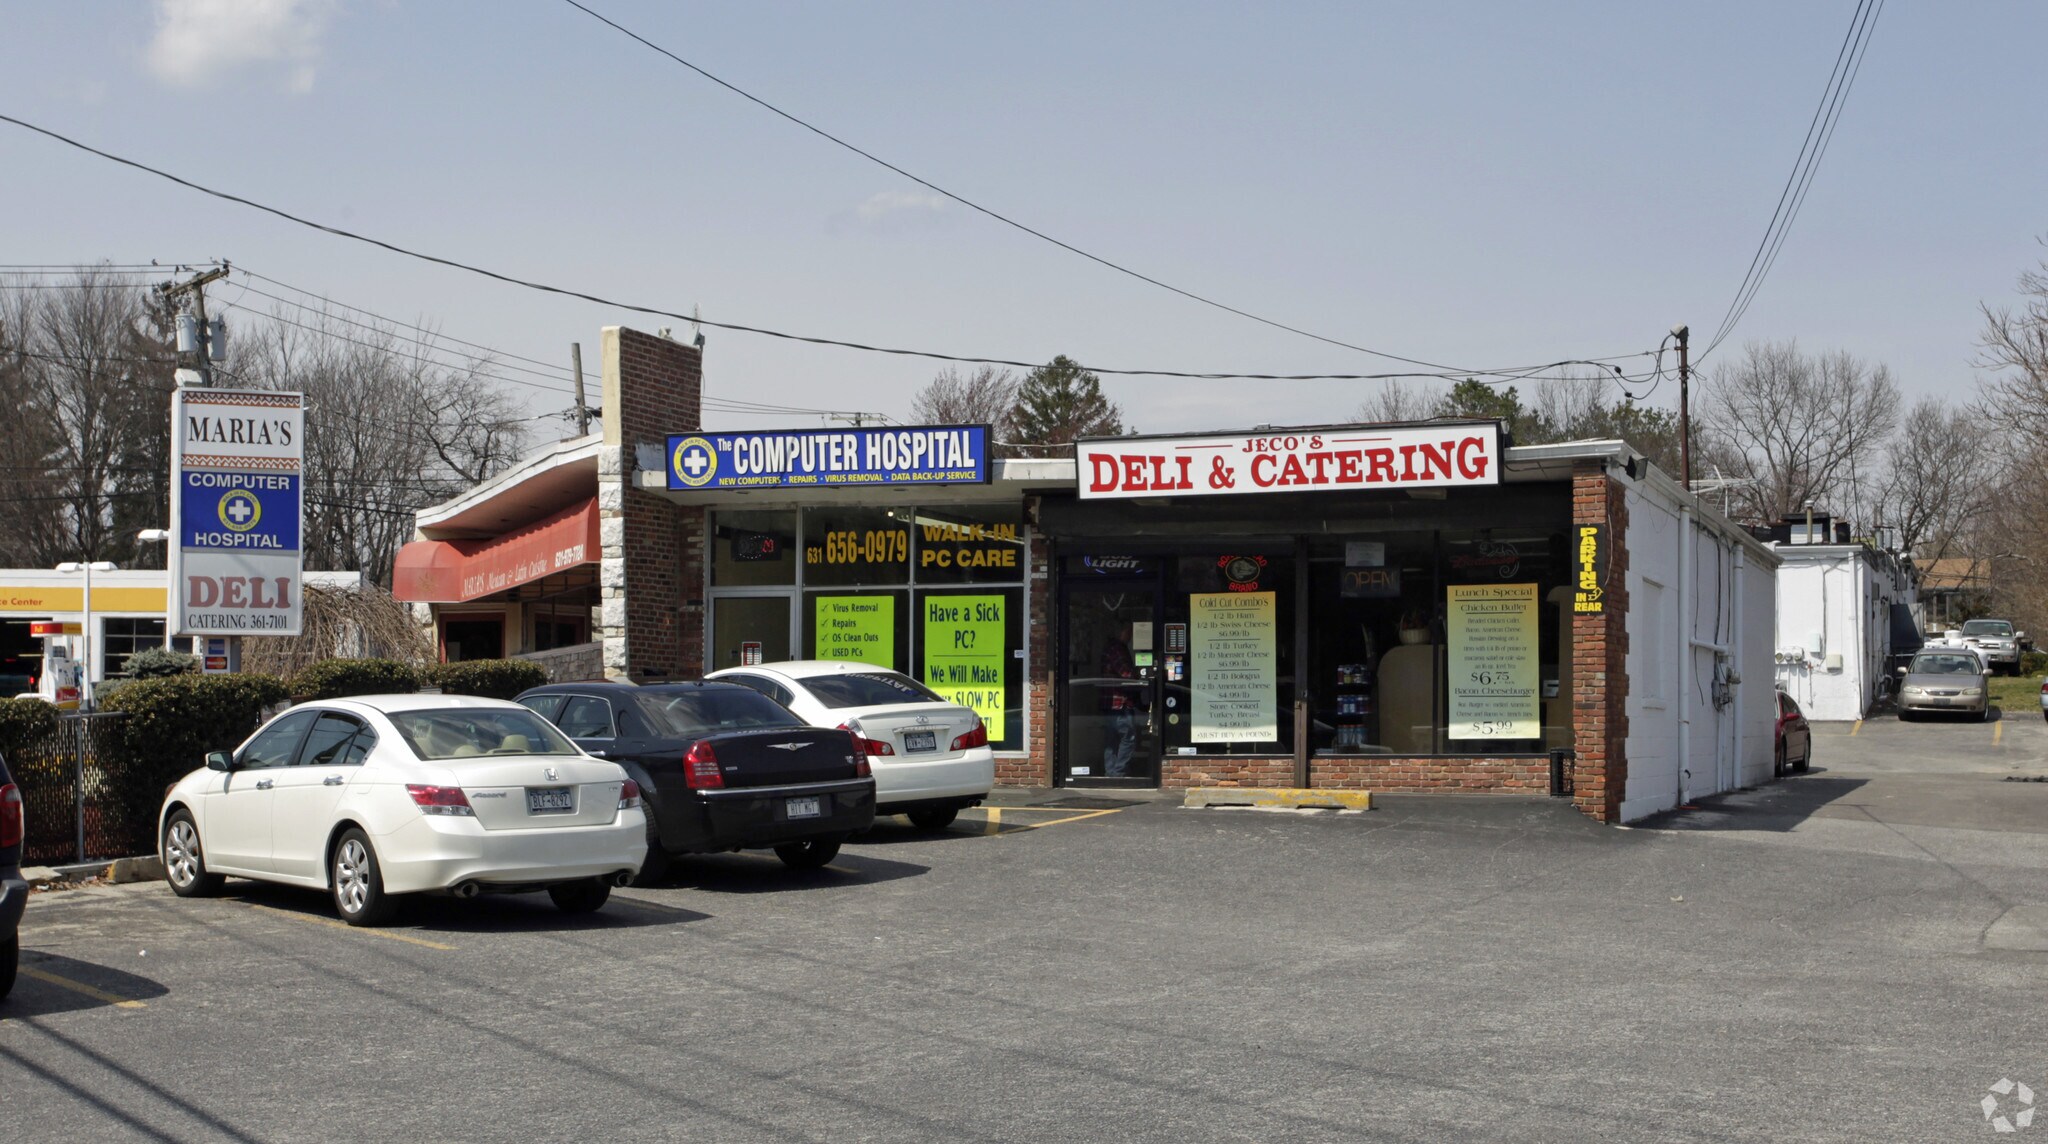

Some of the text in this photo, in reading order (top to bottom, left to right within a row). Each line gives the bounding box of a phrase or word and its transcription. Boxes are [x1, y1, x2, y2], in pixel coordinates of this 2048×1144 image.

[188, 416, 292, 446] MARIA'S
[1242, 436, 1323, 452] JECO'S
[717, 430, 976, 474] The COMPUTER HOSPITAL
[1088, 437, 1488, 492] DELI & CATERING
[189, 473, 289, 490] COMPUTER
[738, 476, 781, 485] COMPUTERS
[789, 475, 817, 483] REPAIRS
[825, 474, 846, 482] VIRUS
[848, 473, 883, 482] REMOVAL
[891, 472, 910, 481] DATA
[912, 472, 945, 480] BACK-UP
[947, 471, 976, 480] SERVICE
[195, 532, 282, 548] HOSPITAL
[922, 524, 1015, 542] WALK-IN
[807, 530, 907, 564] 631 656-0979
[922, 550, 1016, 567] PC CARE
[1092, 560, 1140, 569] LIGHT
[1580, 527, 1598, 589] PARKING
[1228, 582, 1258, 592] BRAND
[1344, 571, 1394, 590] OPEN
[188, 575, 291, 609] DELI
[1493, 588, 1532, 597] Special
[1576, 592, 1586, 602] IN
[11, 598, 43, 606] Center
[832, 603, 878, 613] Virus Removal
[1200, 597, 1268, 608] Cold Cut Combo's
[1574, 602, 1602, 612] REAR
[929, 603, 1000, 622] Have a Sick
[188, 614, 287, 629] CATERING 361-7101
[832, 619, 856, 630] Repairs
[832, 633, 879, 643] OS Clean Outs
[955, 630, 975, 649] PC?
[832, 648, 863, 657] USED PCs
[930, 664, 998, 683] We Will Make
[1471, 671, 1509, 685] $6.75
[1482, 687, 1535, 696] Cheeseburger
[956, 691, 999, 709] SLOW PC
[1473, 720, 1512, 734] $5.99
